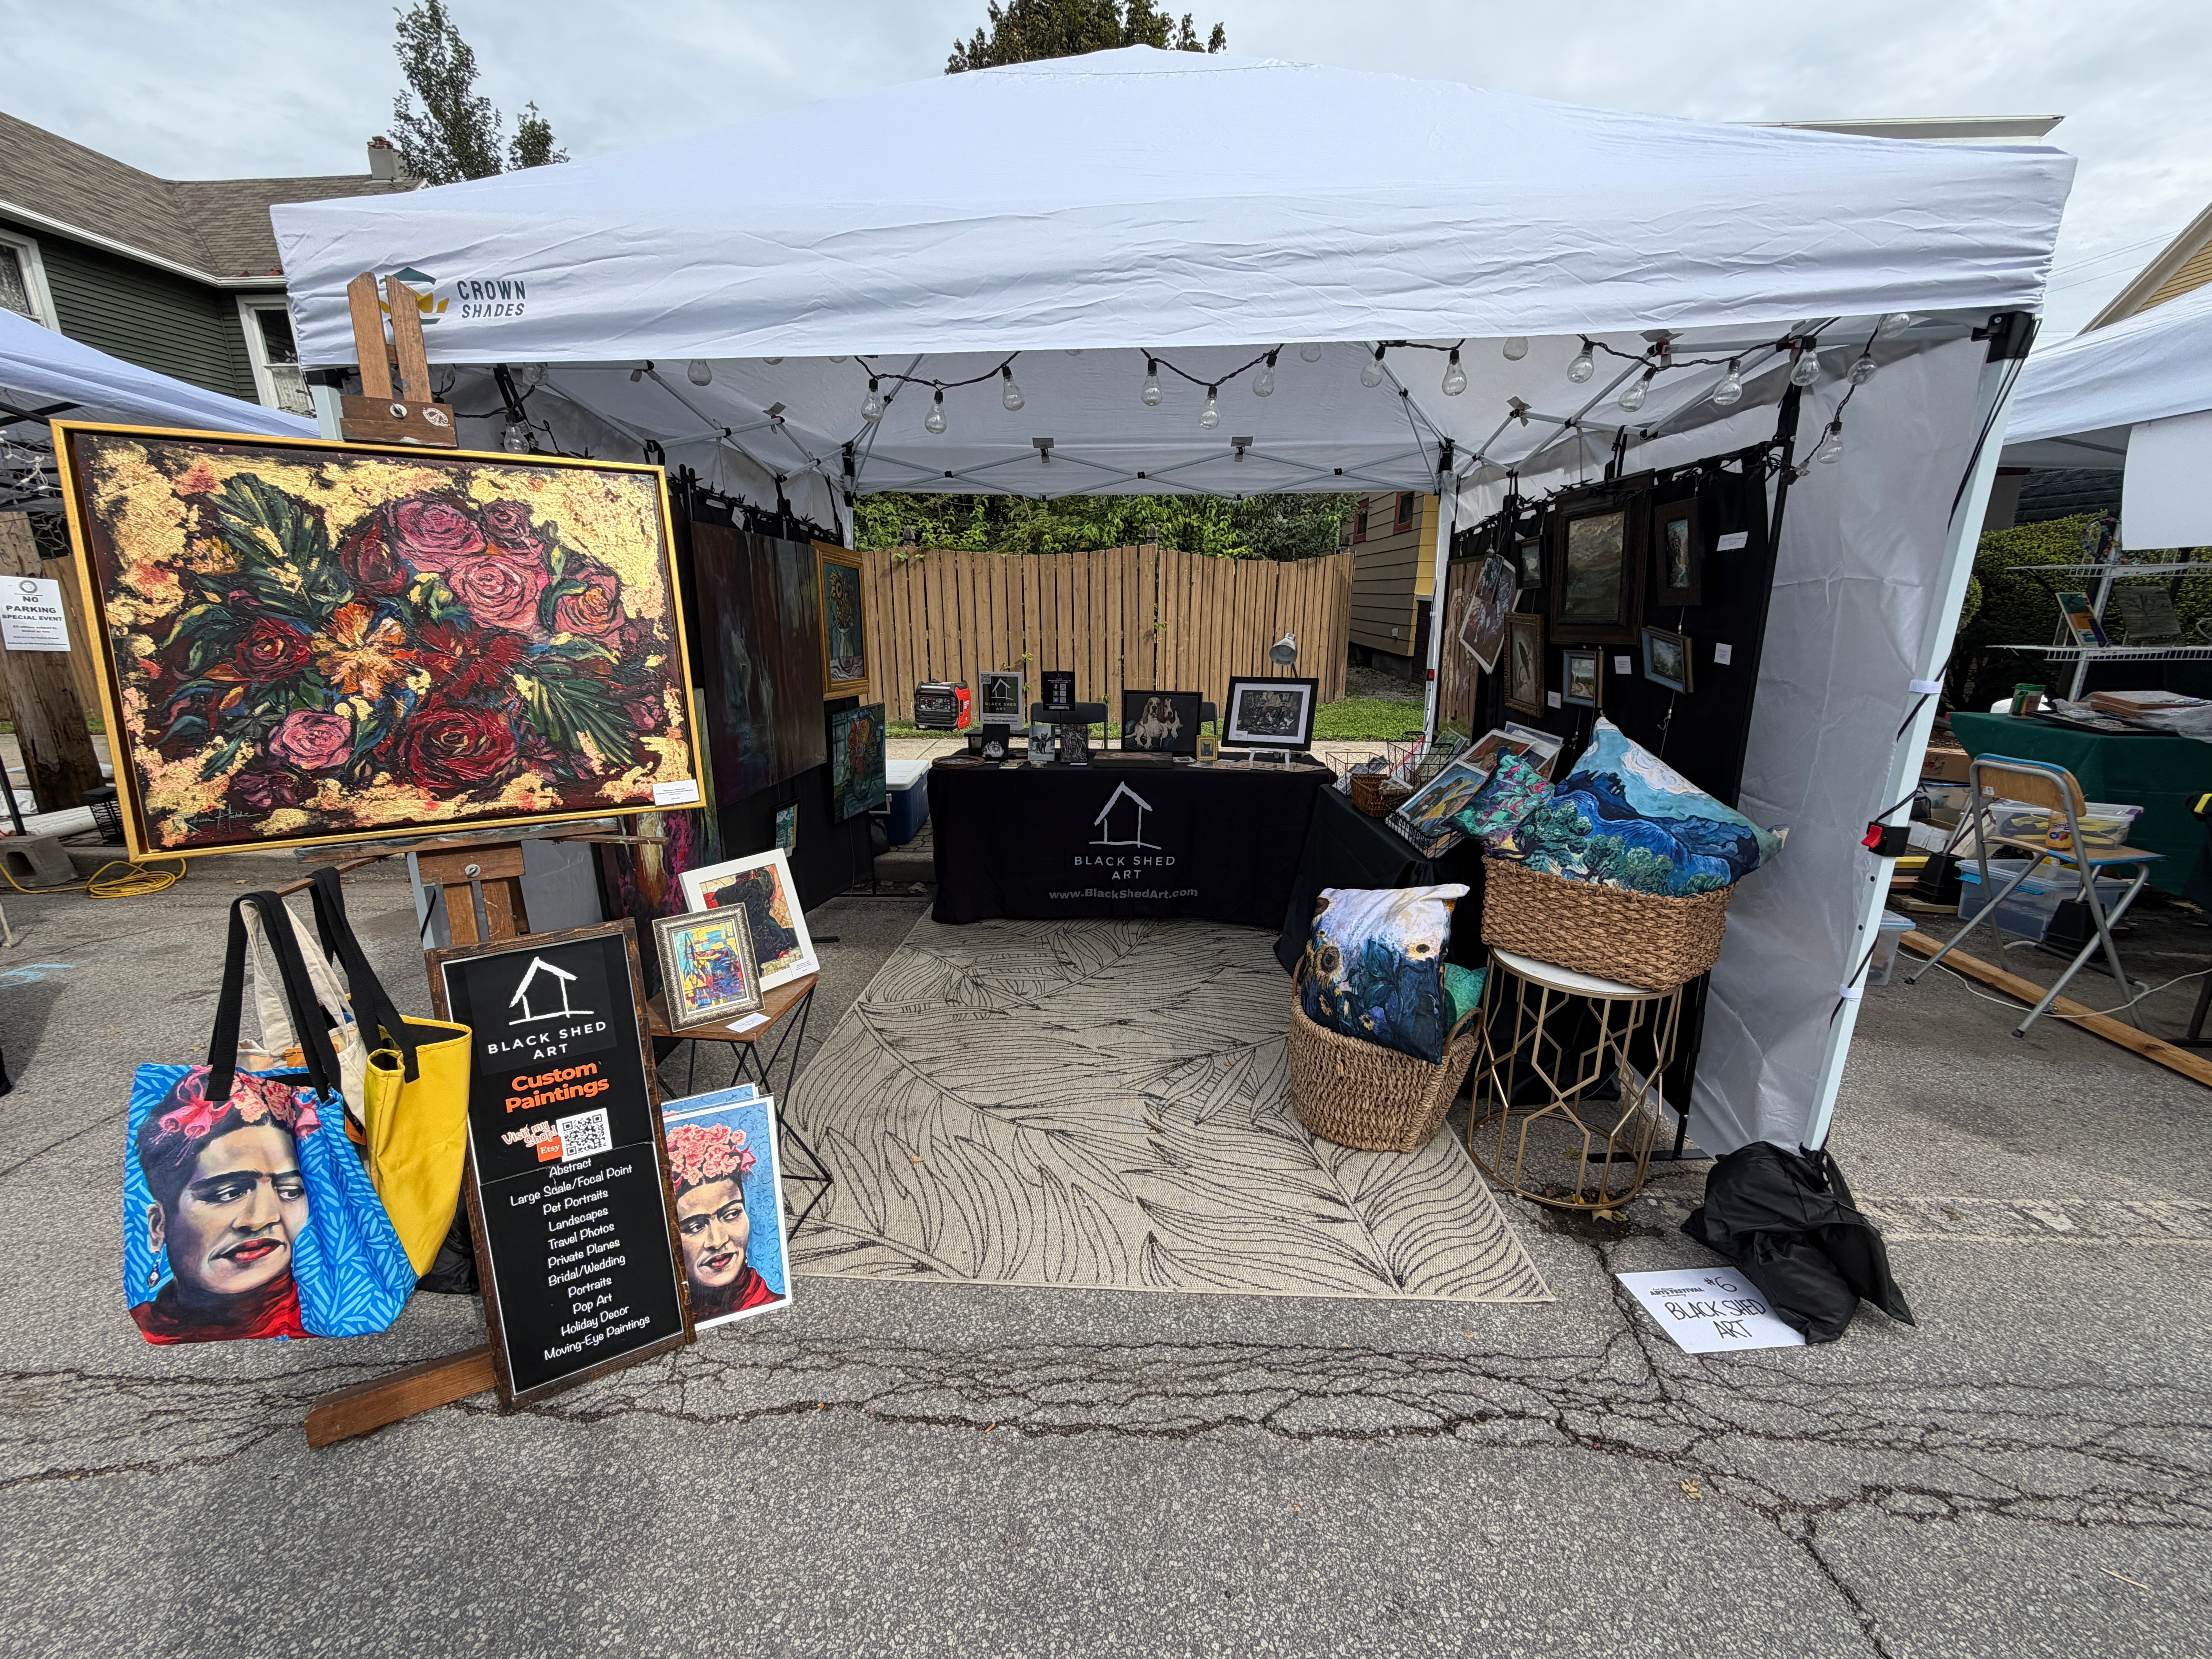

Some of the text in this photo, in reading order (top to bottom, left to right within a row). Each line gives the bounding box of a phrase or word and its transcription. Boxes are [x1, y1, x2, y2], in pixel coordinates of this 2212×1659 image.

[457, 280, 526, 300] CROWN
[462, 303, 525, 318] SHADES
[6, 605, 57, 613] PARKING
[1074, 856, 1175, 866] BLACK SHED
[1111, 870, 1142, 880] ART
[1049, 888, 1198, 899] www.BlackShedArt.com
[488, 1022, 606, 1055] BLACK SHED
[533, 1043, 568, 1060] ART
[512, 1062, 598, 1091] Custom
[505, 1077, 610, 1113] Paintings
[501, 1121, 550, 1145] Visit my
[524, 1125, 558, 1147] Shop!
[540, 1144, 560, 1154] Etsy
[549, 1158, 592, 1178] Abstract
[510, 1164, 632, 1206] Large Scale/Focal Point
[543, 1189, 609, 1216] Pet Portraits
[548, 1207, 608, 1231] Landscapes
[548, 1223, 615, 1250] Travel Photos
[548, 1239, 620, 1268] Private Planes
[548, 1254, 626, 1286] Bridal/Wedding
[568, 1277, 612, 1298] Portraits
[1704, 1276, 1737, 1292] #6
[573, 1293, 612, 1314] Pop Art
[1664, 1298, 1766, 1321] BLACK SHED
[561, 1306, 629, 1337] Holiday Decor
[1712, 1319, 1752, 1339] ART
[544, 1316, 650, 1360] Moving-Eye Paintings
